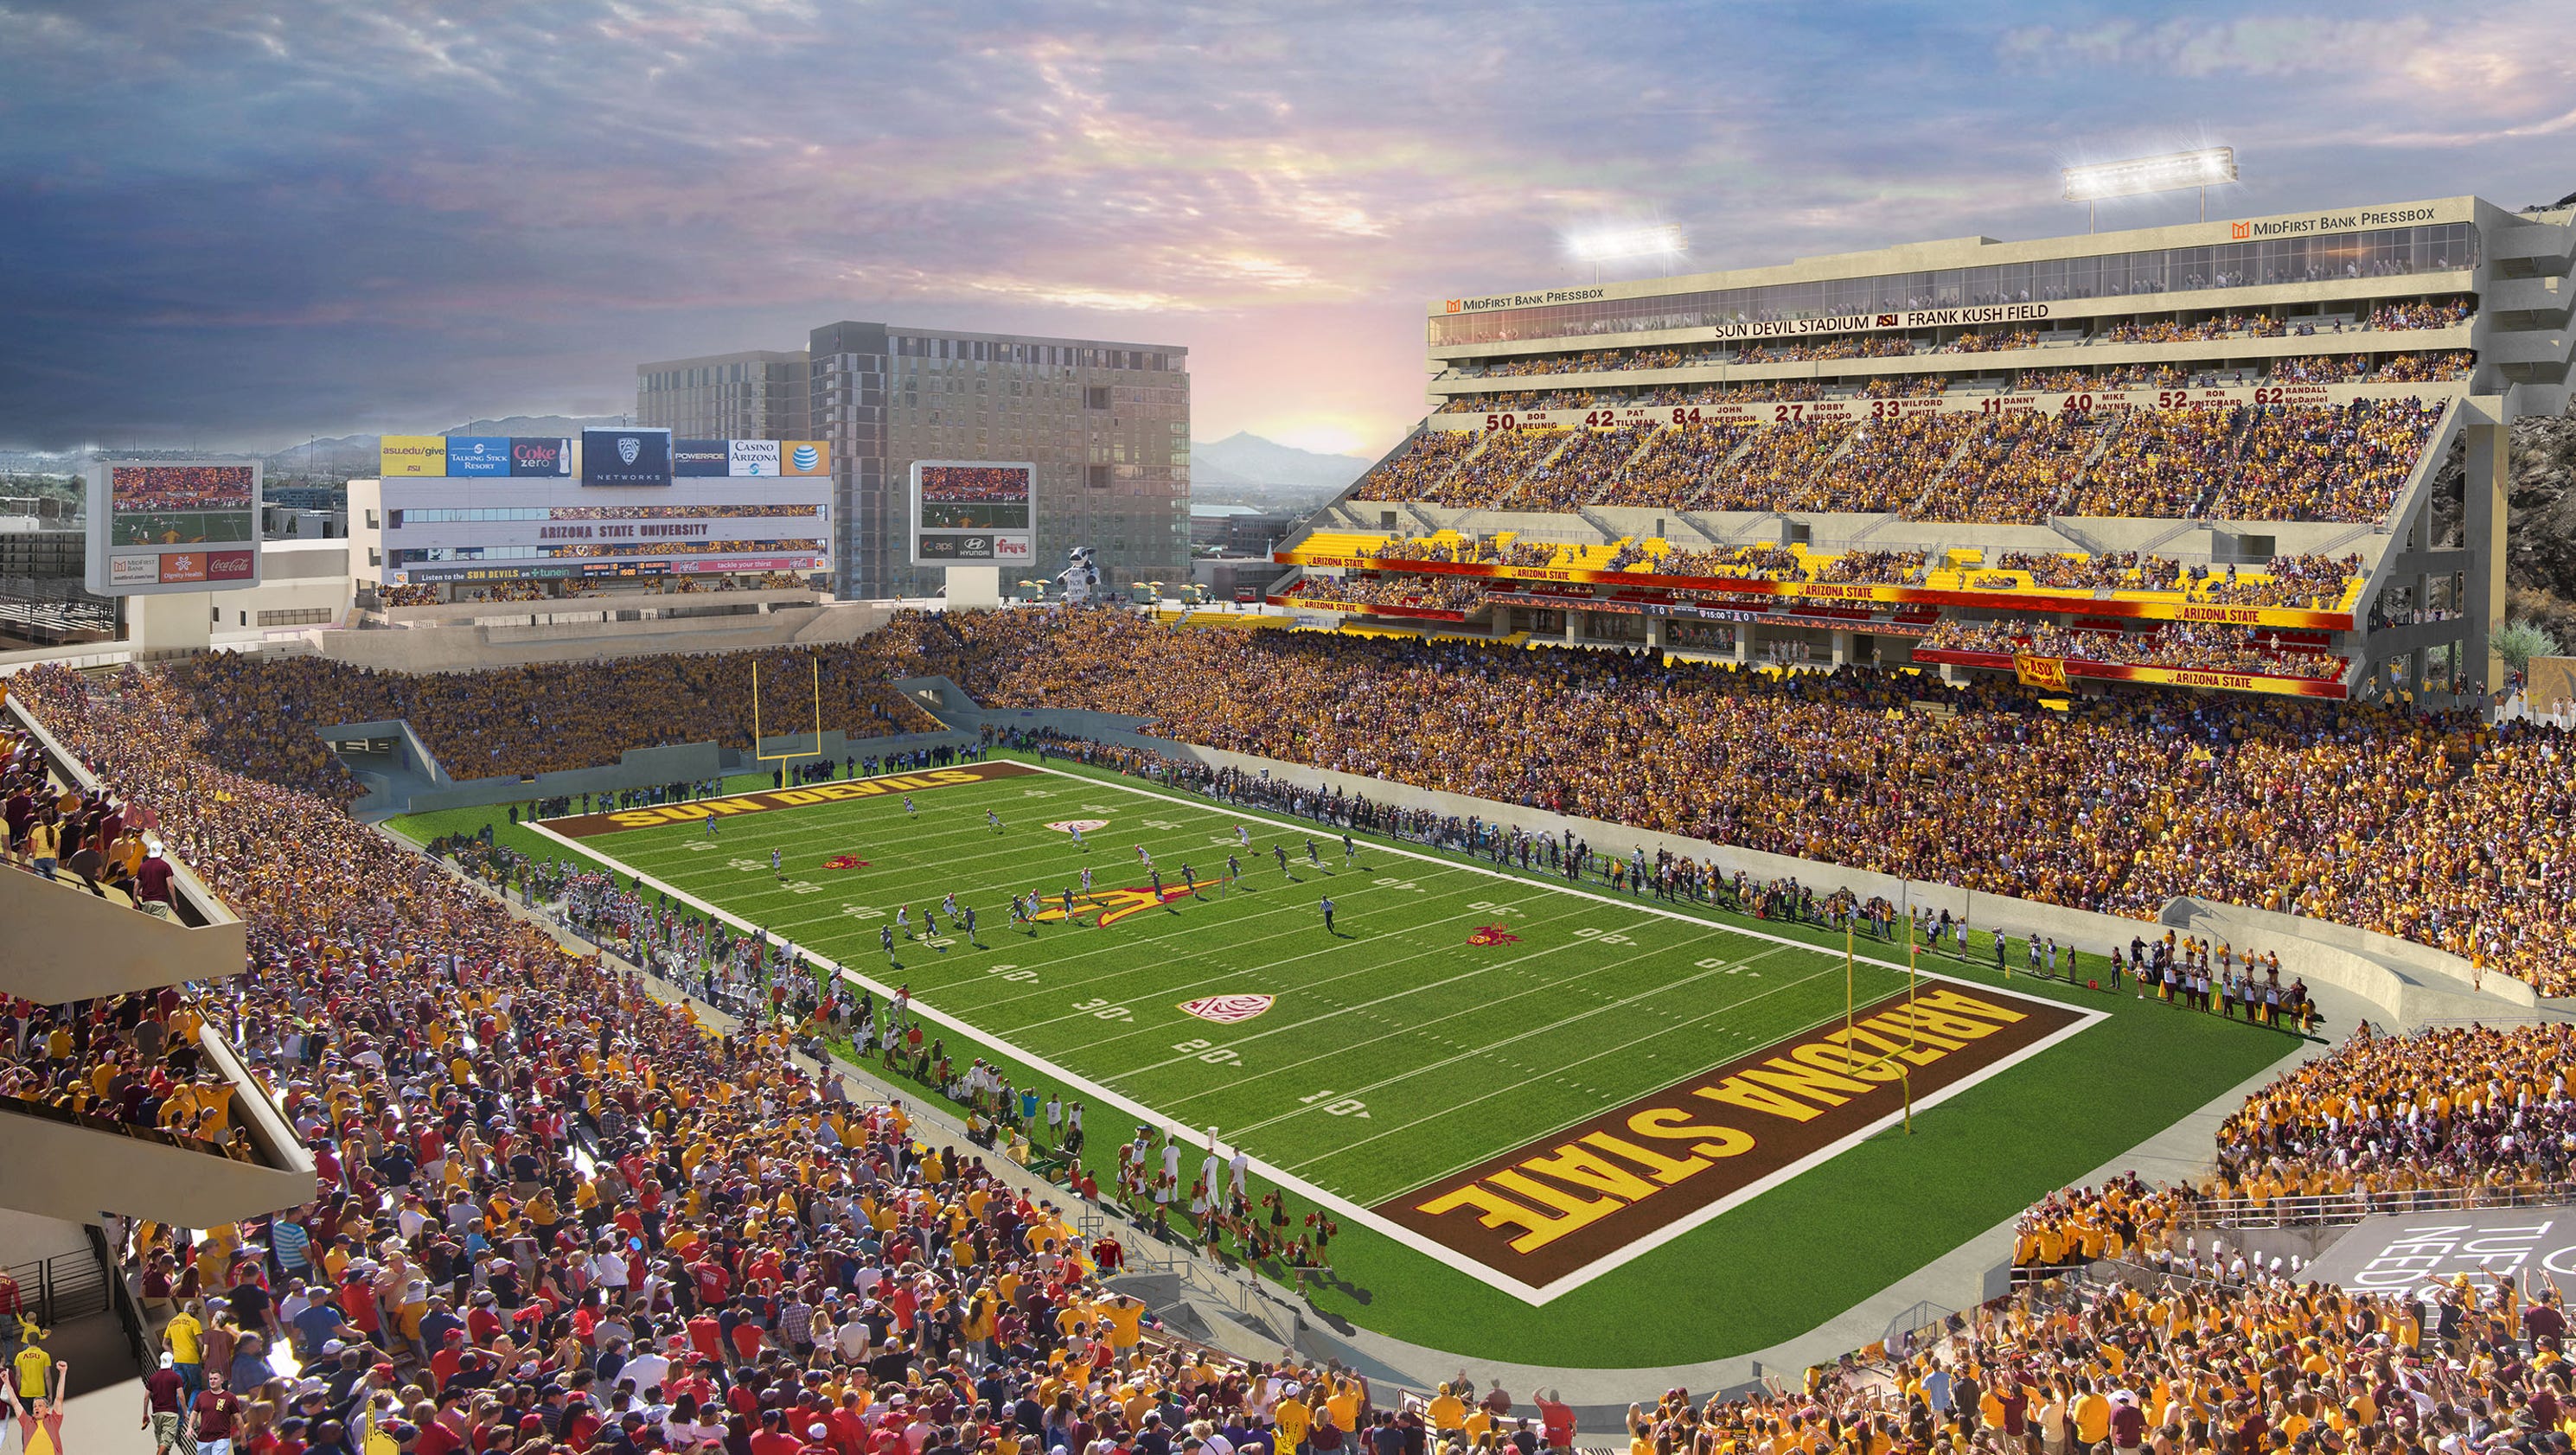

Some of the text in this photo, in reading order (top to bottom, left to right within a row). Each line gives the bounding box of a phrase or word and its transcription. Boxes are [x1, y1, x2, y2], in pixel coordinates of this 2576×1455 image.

[2320, 216, 2357, 230] BANK
[2362, 208, 2435, 226] PRESSBOX
[1515, 295, 1543, 306] BANK
[1546, 289, 1604, 303] PRESSBOX
[1715, 303, 2049, 339] SUN DEVIL STADIUM ASU FRANK KUSH FIELD
[2254, 387, 2284, 405] 62
[2285, 386, 2328, 394] RANDALL
[1901, 399, 1943, 408] WILFORD
[1981, 398, 2001, 414] 11
[2063, 394, 2093, 411] 40
[2158, 391, 2188, 408] 52
[2189, 399, 2242, 408] PRITCHARD
[2285, 396, 2328, 405] McDaniel
[1672, 408, 1702, 424] 84
[1774, 405, 1804, 422] 27
[1806, 412, 1851, 421] MULGADO
[1870, 400, 1900, 418] 33
[1486, 413, 1514, 431] 50
[1516, 422, 1557, 431] BREUNIG
[1585, 411, 1614, 427] 42
[1615, 418, 1656, 427] TILLMAN
[1702, 415, 1756, 424] JEFFERSON
[382, 446, 445, 457] asu.edu/give
[514, 444, 556, 461] Coke
[735, 441, 774, 452] CASINO
[451, 453, 508, 462] TALKING STICK
[521, 458, 550, 468] zero
[731, 451, 778, 462] ARIZONA
[540, 523, 708, 539] ARIZONA STATE UNIVERSITY
[936, 541, 953, 552] aps
[1312, 556, 1365, 568] ARIZONA STATE
[467, 571, 486, 580] SUN
[488, 570, 519, 579] DEVILS
[1517, 569, 1570, 580] ARIZONA STATE
[1805, 584, 1874, 598] ARIZONA STATE
[1304, 601, 1357, 612] ARIZONA STATE
[1706, 610, 1725, 619] 15:00
[2183, 607, 2260, 622] ARIZONA STATE
[2030, 660, 2053, 676] ASU
[2176, 673, 2253, 689] ARIZONA STATE
[607, 769, 984, 827] SUN DEVILS
[987, 964, 1038, 981] 40
[1071, 998, 1130, 1021] 30
[1173, 1038, 1239, 1066] 20
[1298, 1089, 1367, 1116] 10
[1413, 988, 2029, 1256] ARIZONA STATE
[2431, 1221, 2554, 1278] TUFT
[22, 1351, 42, 1360] ASU
